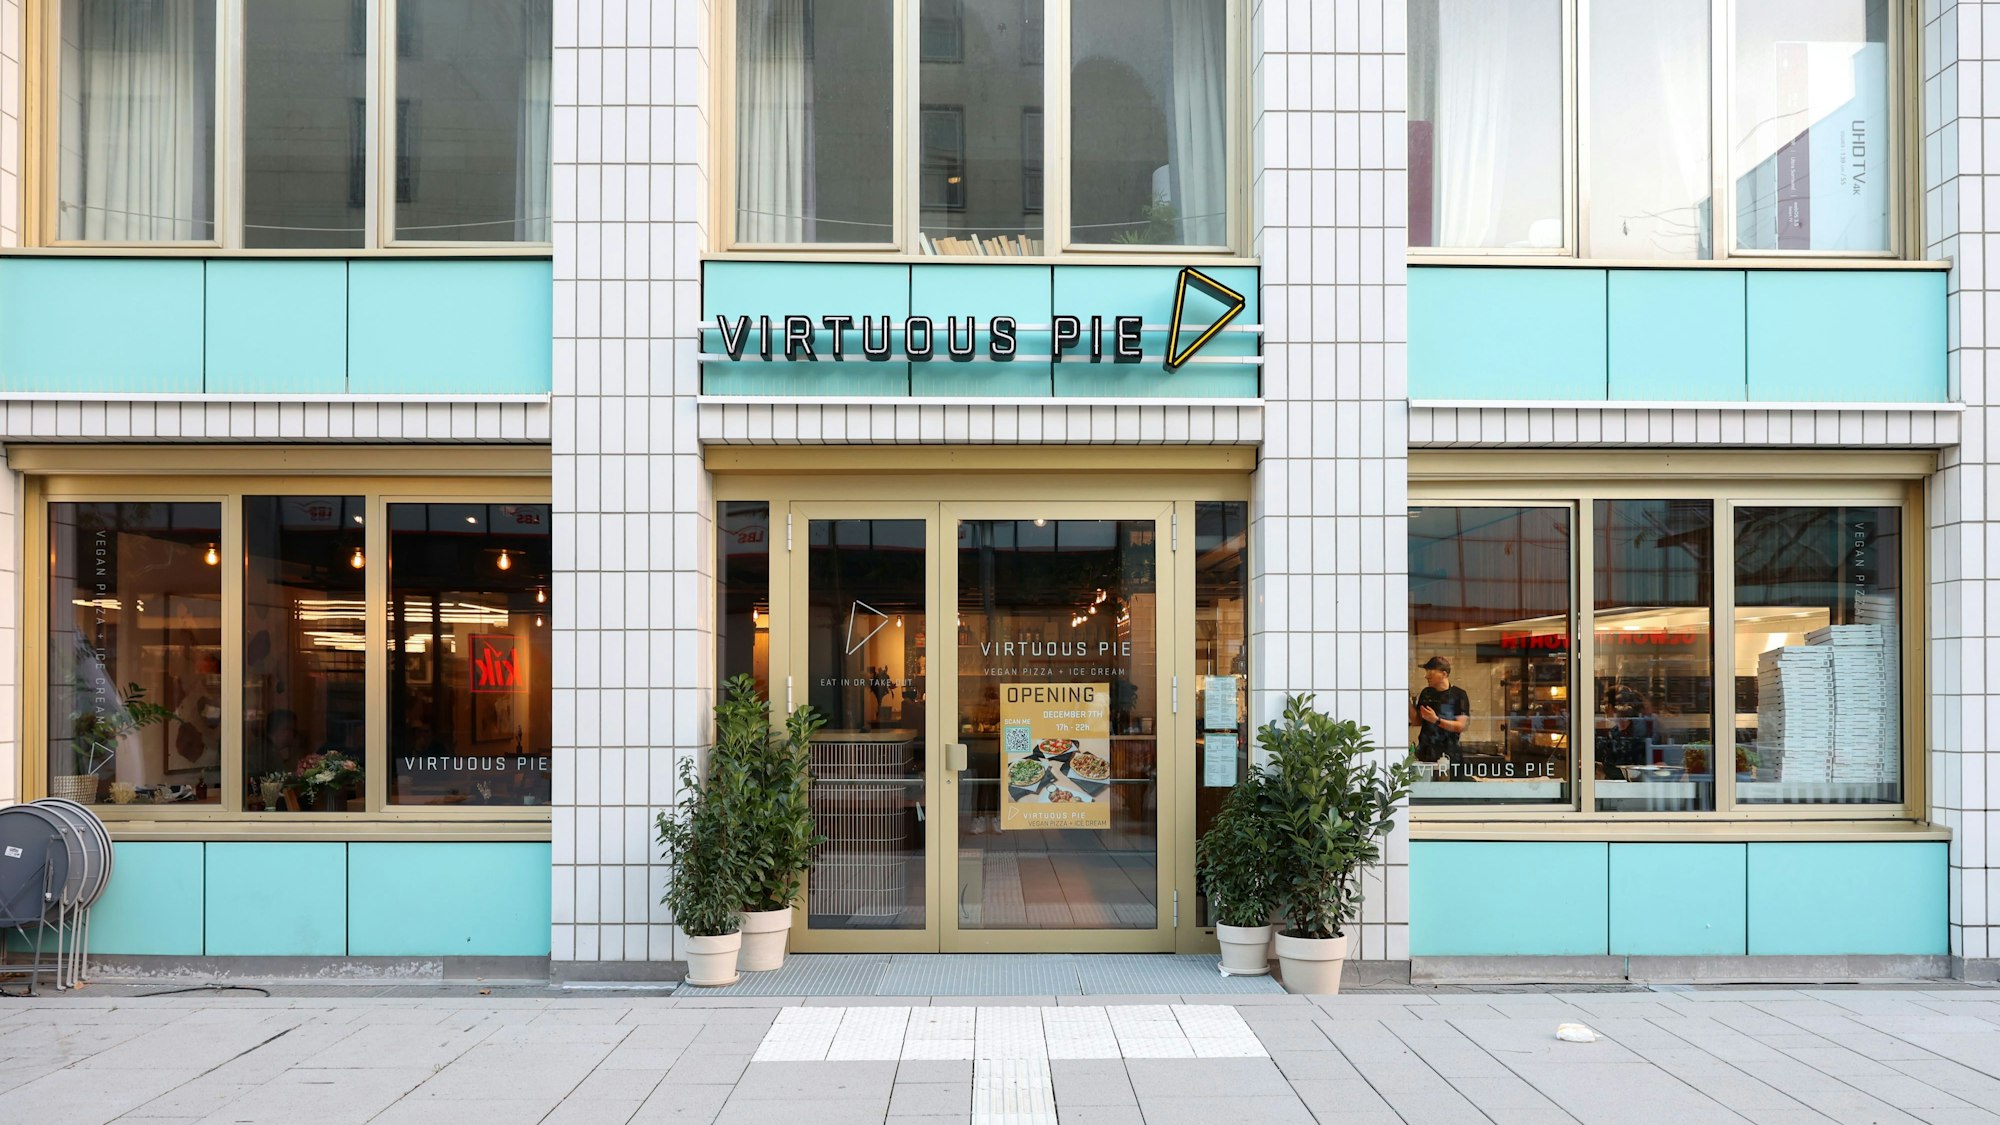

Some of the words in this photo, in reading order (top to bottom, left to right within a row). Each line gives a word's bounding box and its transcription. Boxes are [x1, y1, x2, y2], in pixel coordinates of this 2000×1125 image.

[1851, 120, 1866, 157] UHD
[716, 315, 1018, 362] VIRTUOUS
[1051, 315, 1143, 363] PIE
[95, 530, 107, 576] VEGAN
[1854, 522, 1865, 567] VEGAN
[95, 583, 107, 625] PIZA
[1855, 574, 1865, 616] PIZZA
[980, 642, 1088, 656] VIRTUOUS
[1099, 642, 1131, 656] PIE
[95, 648, 106, 670] ICE
[984, 668, 1018, 676] VEGAN
[1022, 668, 1052, 676] PIZZA
[1069, 667, 1085, 675] ICE
[1091, 667, 1125, 675] CREAM
[820, 678, 837, 686] EAT
[841, 678, 850, 686] IN
[853, 678, 866, 686] OR
[95, 677, 106, 725] CREAM
[1007, 687, 1094, 703] OPENING
[1043, 710, 1086, 719] DECEMBER
[1088, 710, 1103, 718] 7TH
[1056, 723, 1069, 731] 17h
[1075, 723, 1090, 731] 22h
[405, 756, 506, 771] VIRTUOUS
[517, 756, 548, 771] PIE
[1417, 763, 1515, 777] VIRTUOUS
[1525, 762, 1555, 776] PIE
